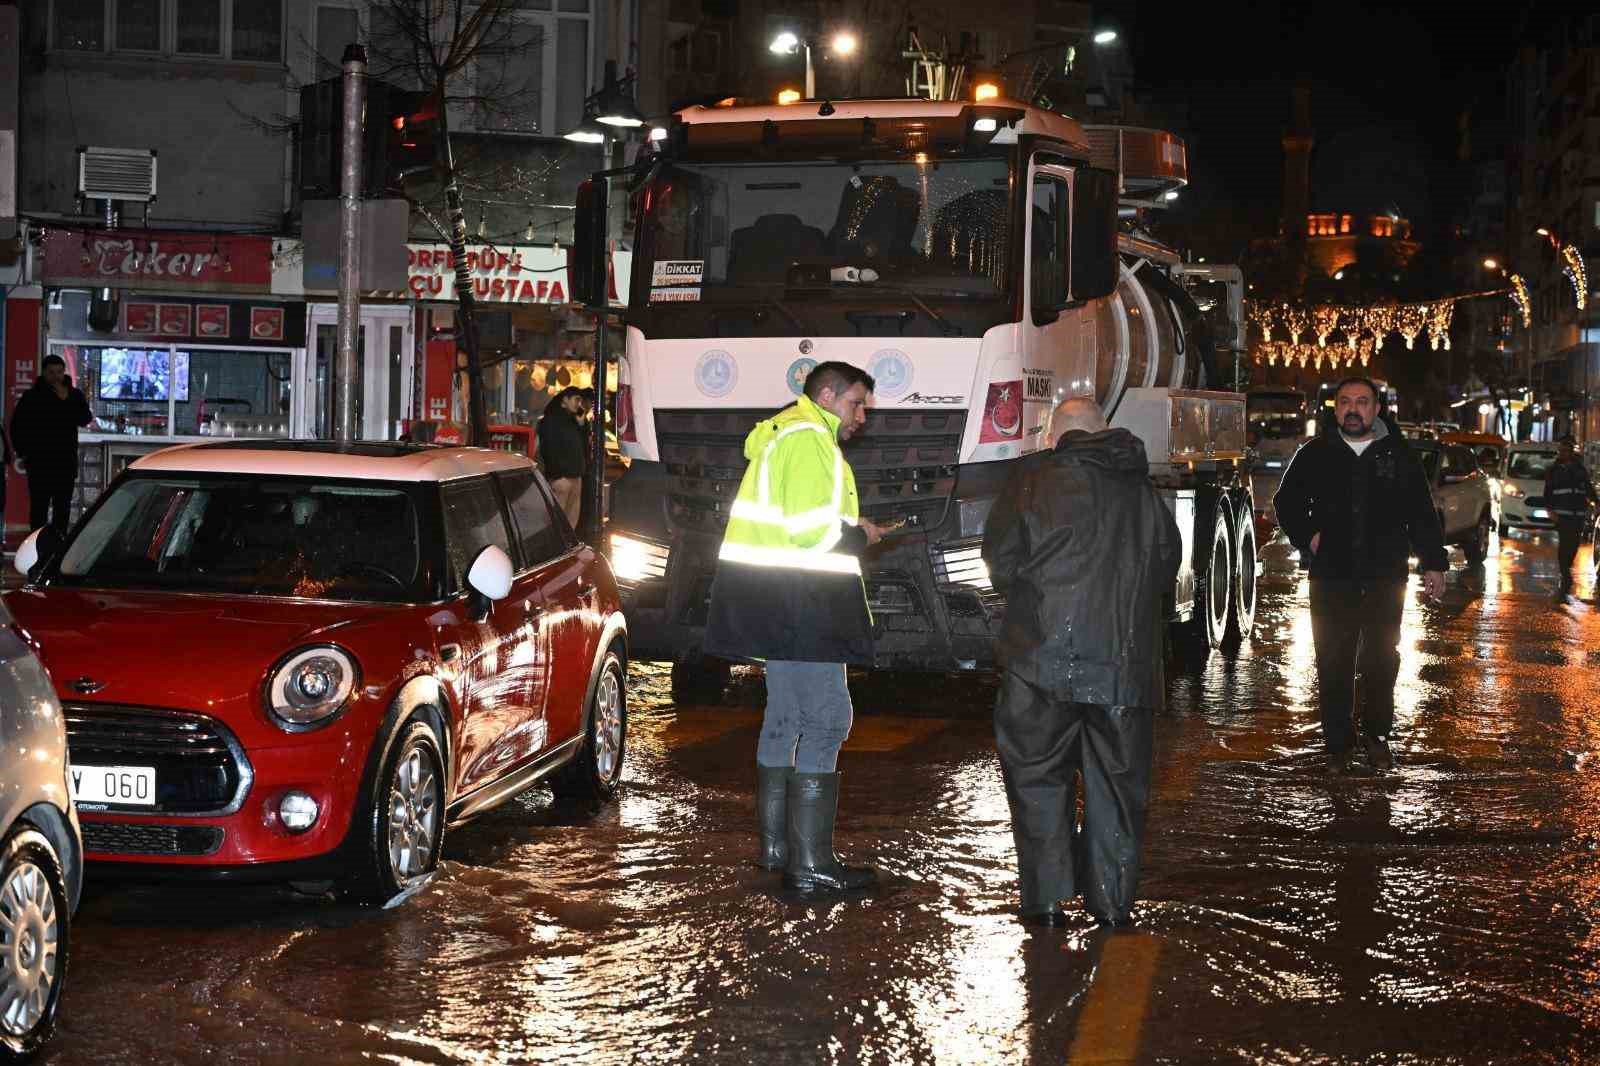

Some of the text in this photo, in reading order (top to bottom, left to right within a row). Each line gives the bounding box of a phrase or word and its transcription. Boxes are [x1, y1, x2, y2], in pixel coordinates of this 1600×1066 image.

[666, 263, 702, 274] DİKKAT
[453, 277, 565, 298] USTAFA
[104, 773, 148, 799] 060
